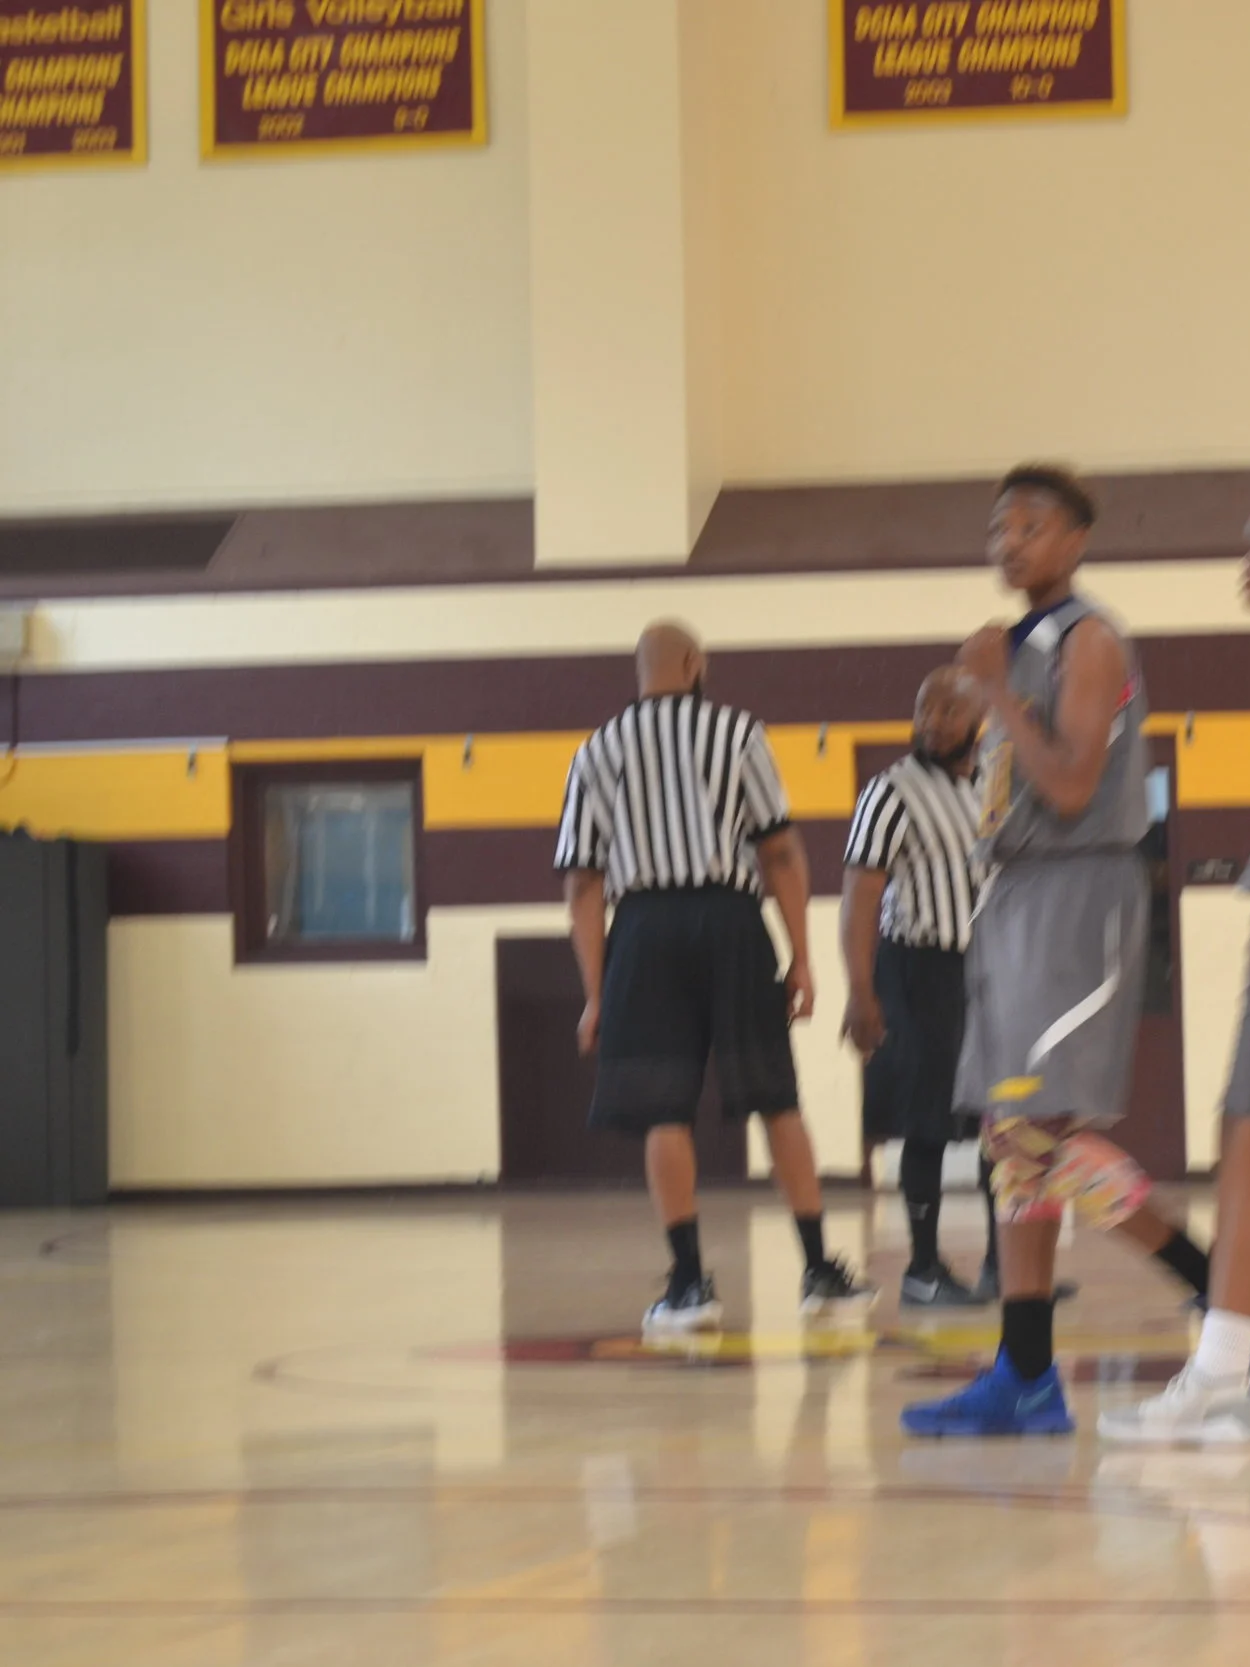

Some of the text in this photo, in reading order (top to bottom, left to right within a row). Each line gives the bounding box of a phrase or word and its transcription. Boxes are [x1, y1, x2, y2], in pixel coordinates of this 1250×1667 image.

[0, 5, 123, 45] asketball
[922, 0, 970, 38] CITY
[976, 0, 1098, 36] CHAMPIONS
[289, 33, 334, 73] CITY
[340, 27, 460, 68] CHAMPIONS
[873, 31, 1082, 79] LEAGUE CHAMPIONS
[5, 52, 124, 92] CHAMPIONS
[243, 64, 442, 112] LEAGUE CHAMPIONS
[0, 88, 106, 129] HAMPIONS
